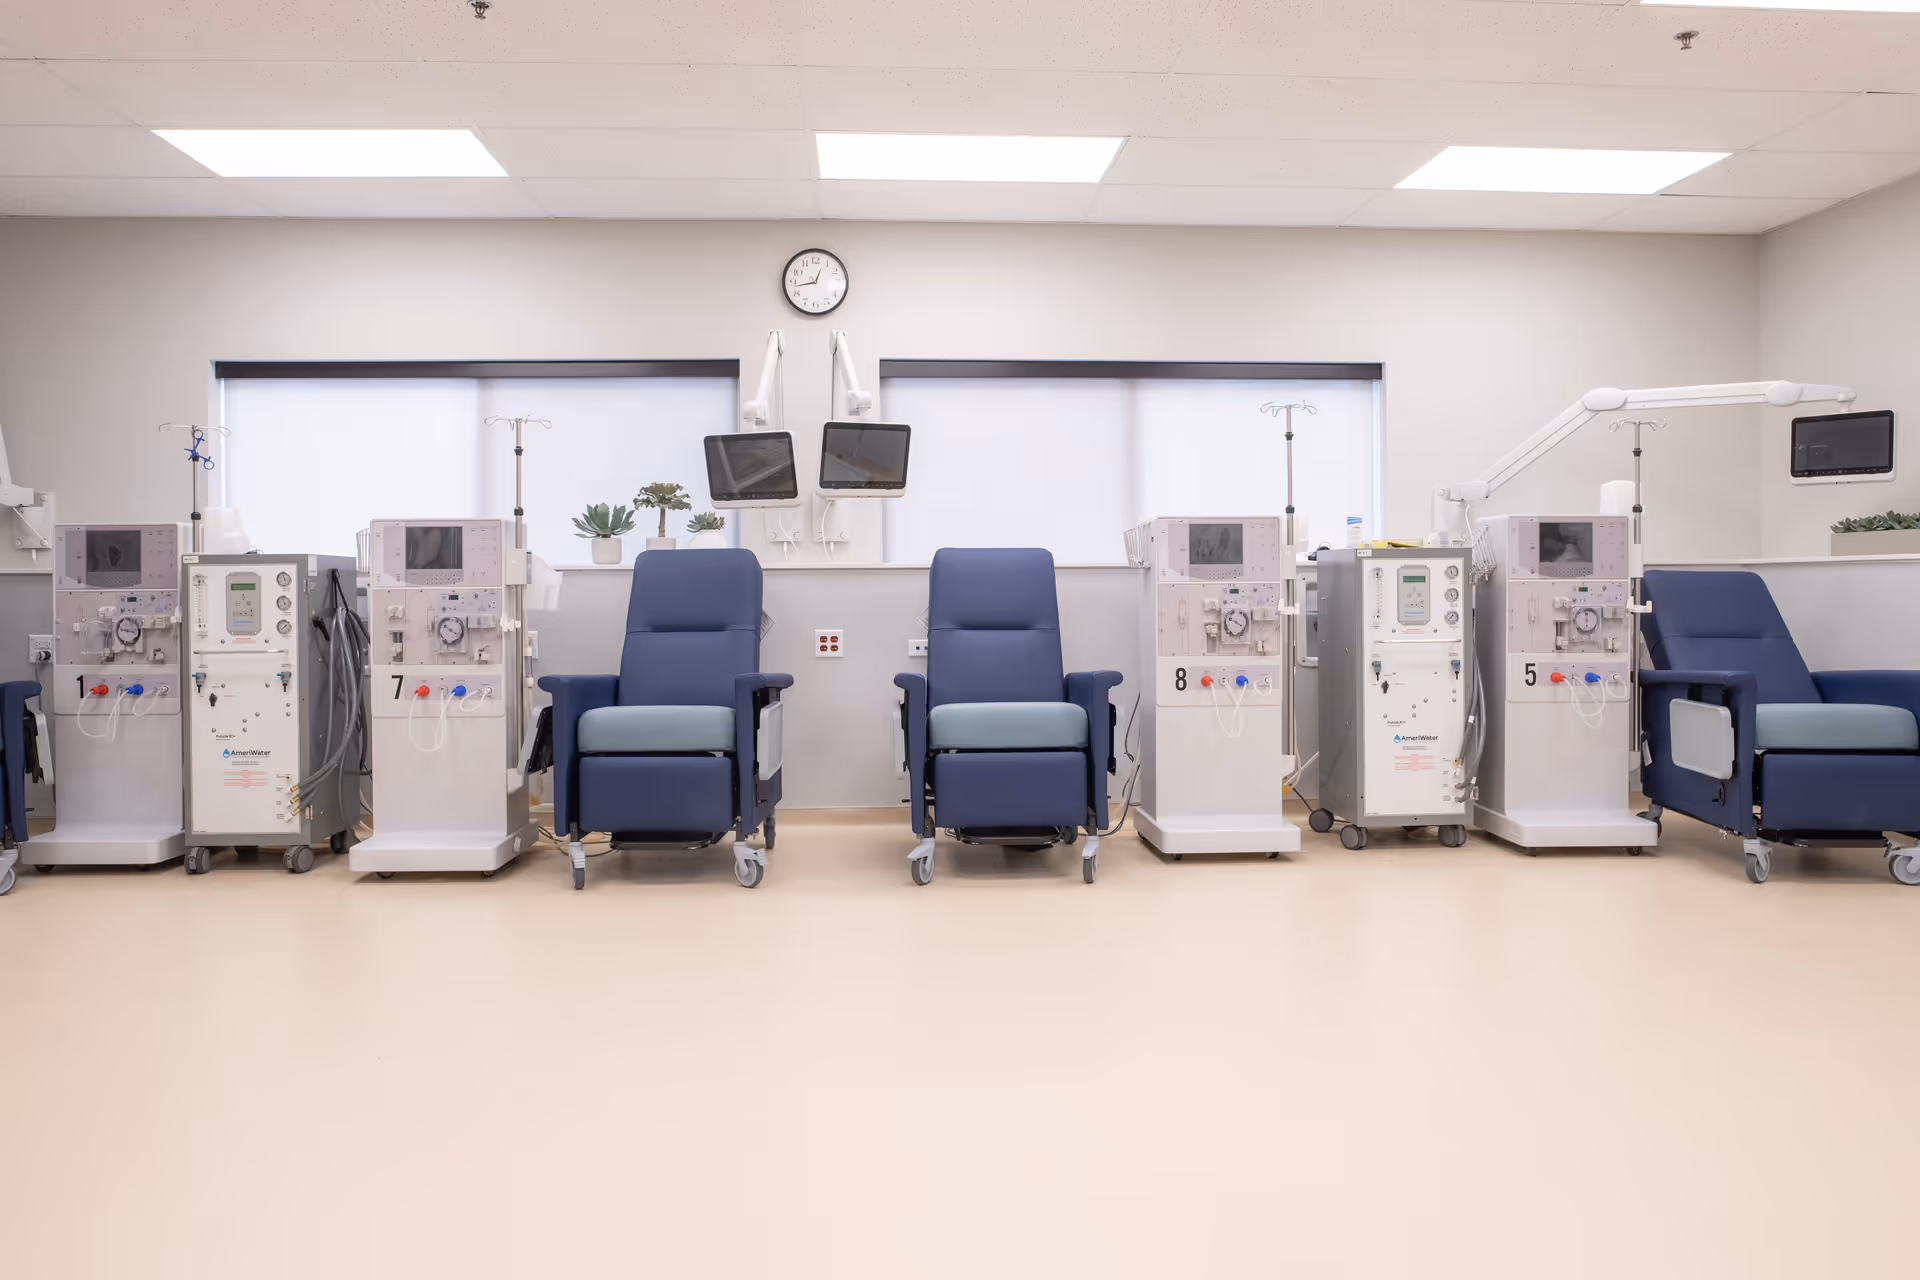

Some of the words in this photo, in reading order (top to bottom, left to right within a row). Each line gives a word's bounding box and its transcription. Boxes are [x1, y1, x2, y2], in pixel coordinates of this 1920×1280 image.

[802, 259, 808, 267] 11
[811, 256, 820, 264] 12
[793, 268, 803, 276] 10
[789, 279, 797, 287] 9
[802, 298, 808, 306] 7
[812, 301, 819, 309] 6
[823, 298, 830, 306] 5
[1525, 663, 1537, 686] 5
[1175, 667, 1188, 691] 8
[76, 675, 85, 699] 1
[391, 674, 404, 700] 7
